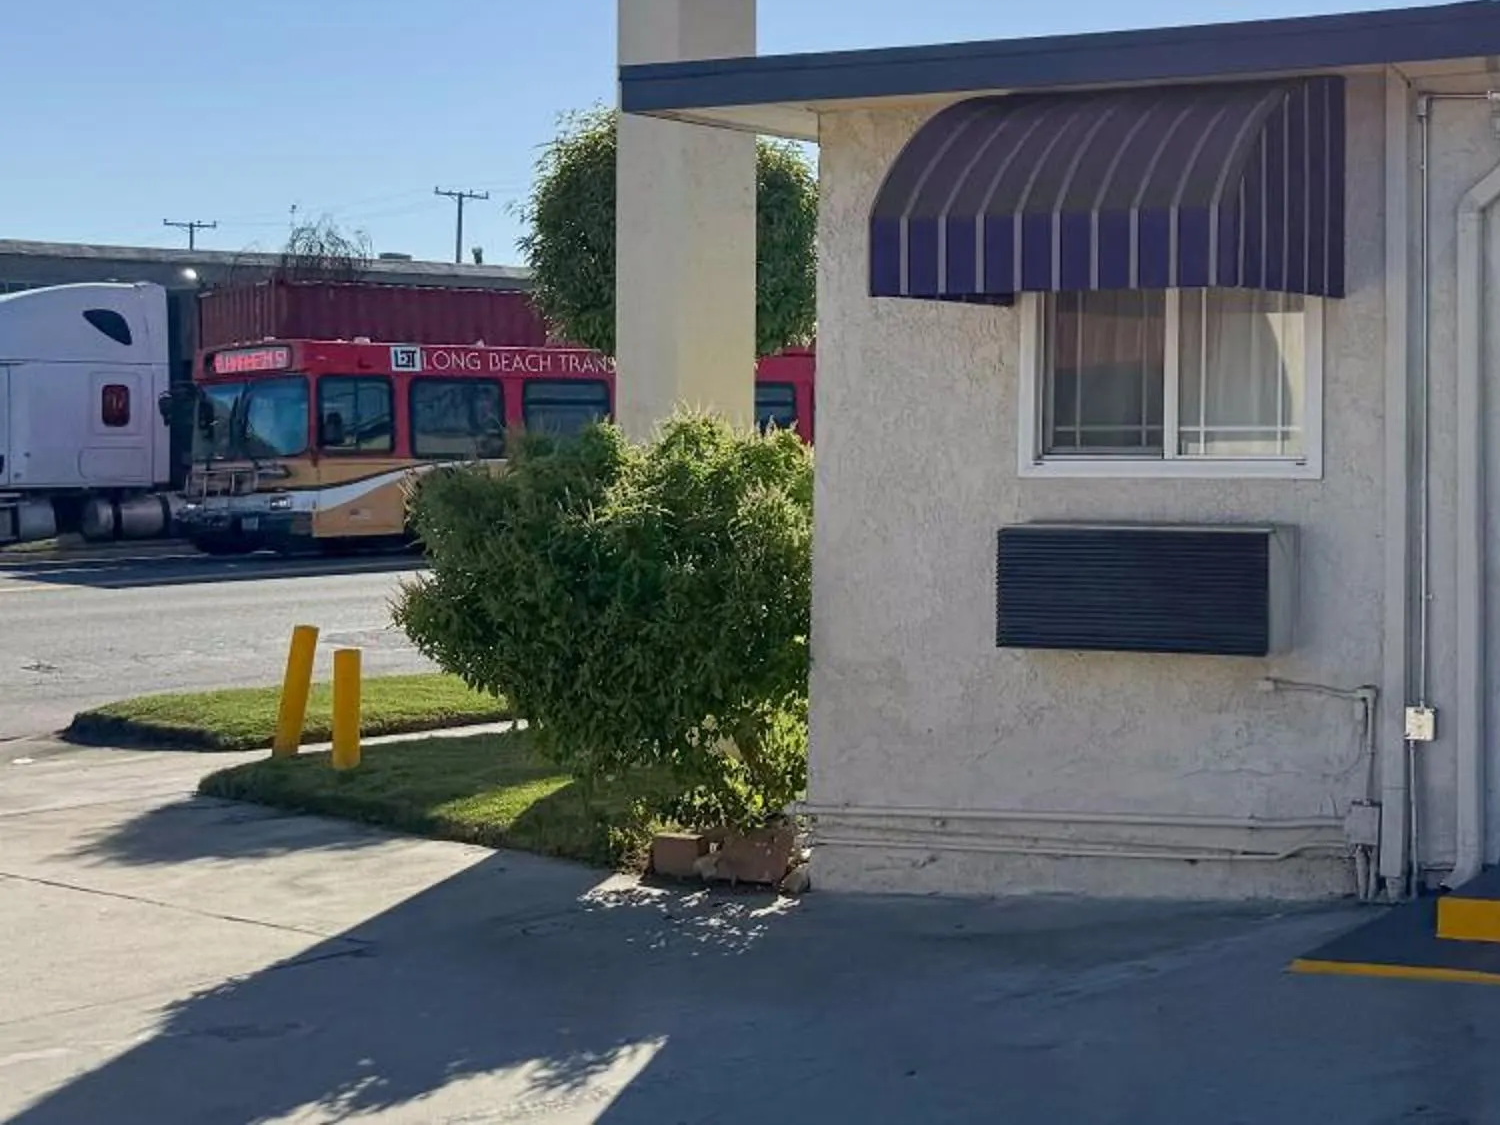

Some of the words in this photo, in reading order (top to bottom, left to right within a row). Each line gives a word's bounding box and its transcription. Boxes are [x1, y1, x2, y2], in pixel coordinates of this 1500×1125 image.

[423, 350, 481, 370] LONG
[489, 353, 550, 372] BEACH
[560, 355, 616, 374] TRANS
